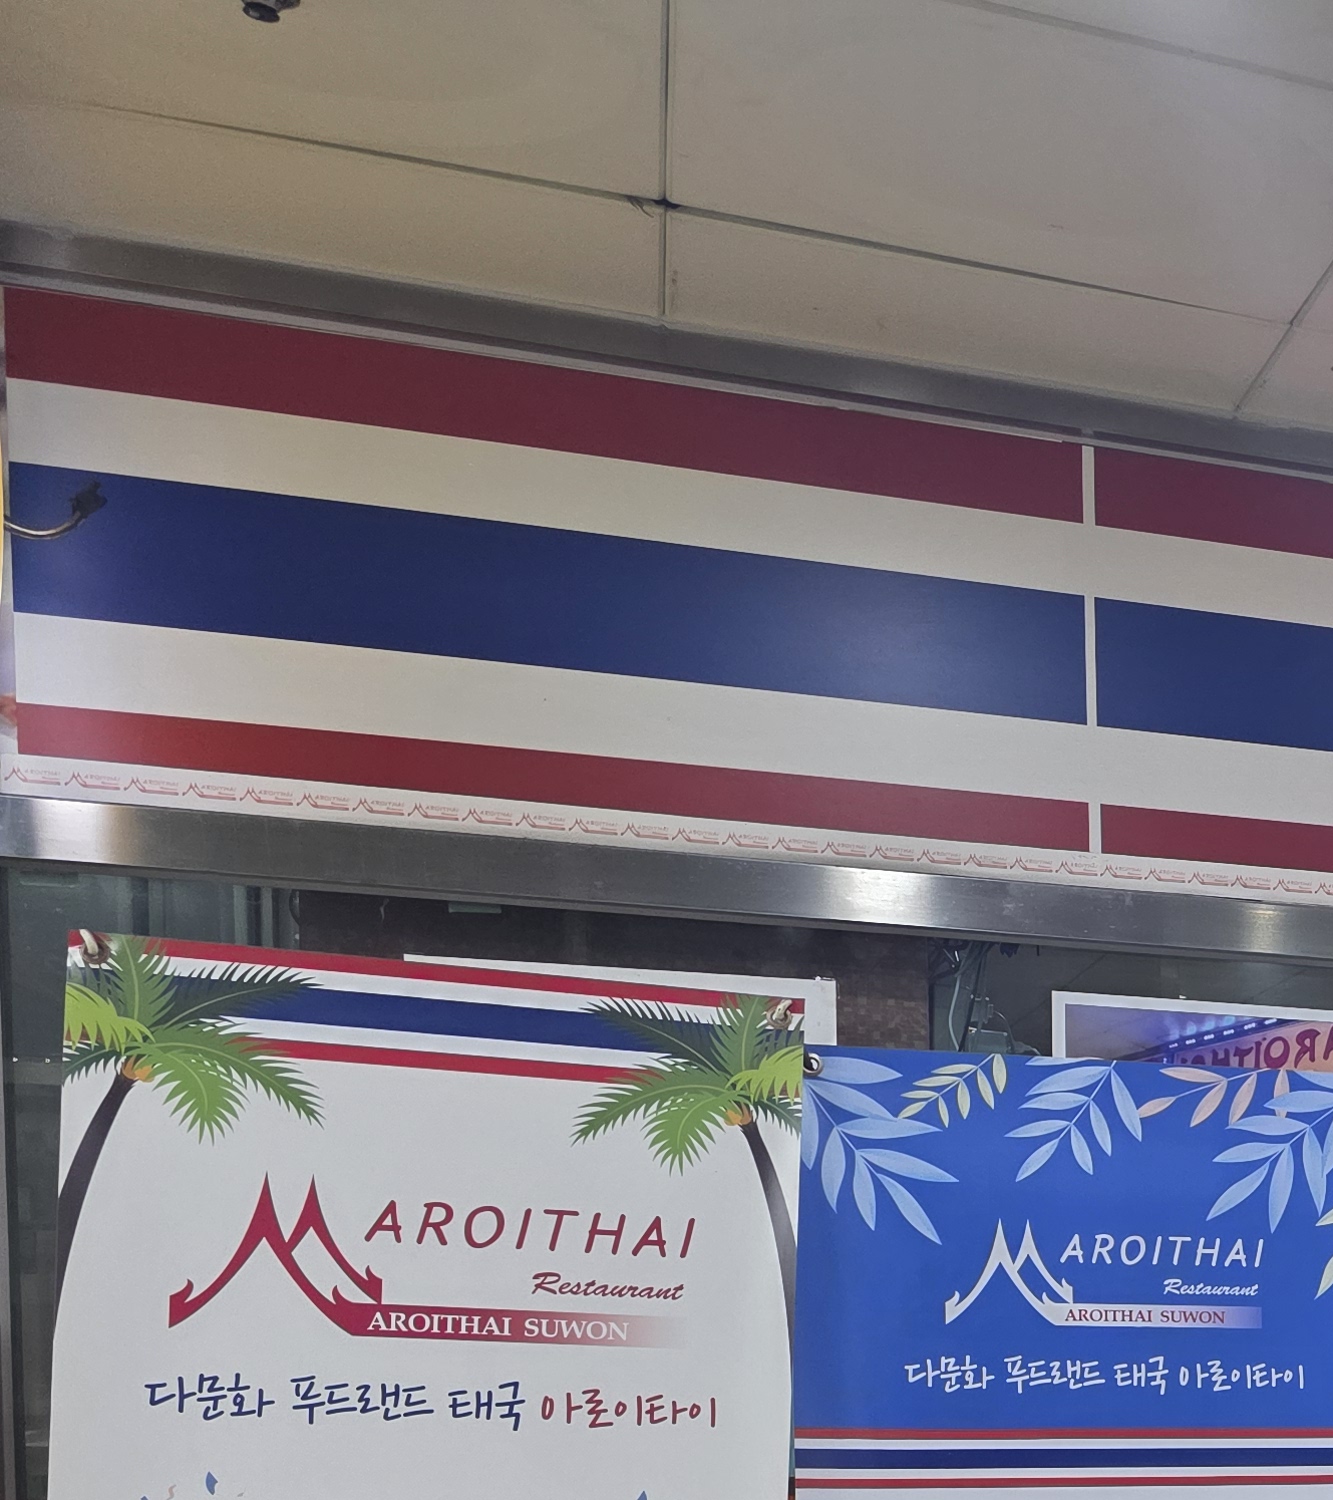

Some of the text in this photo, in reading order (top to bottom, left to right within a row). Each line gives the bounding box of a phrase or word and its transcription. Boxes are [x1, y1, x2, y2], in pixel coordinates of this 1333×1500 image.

[531, 1272, 685, 1302] Restaurant
[1163, 1278, 1259, 1297] Restaurant
[367, 1311, 629, 1342] AROITHAI SUWON
[1065, 1308, 1226, 1325] AROITHAI SUWON
[905, 1355, 1305, 1395] 다문화 푸드랜드 태국 아로이타이
[145, 1373, 716, 1431] 다문화 푸드랜드 태국 아로이타이
